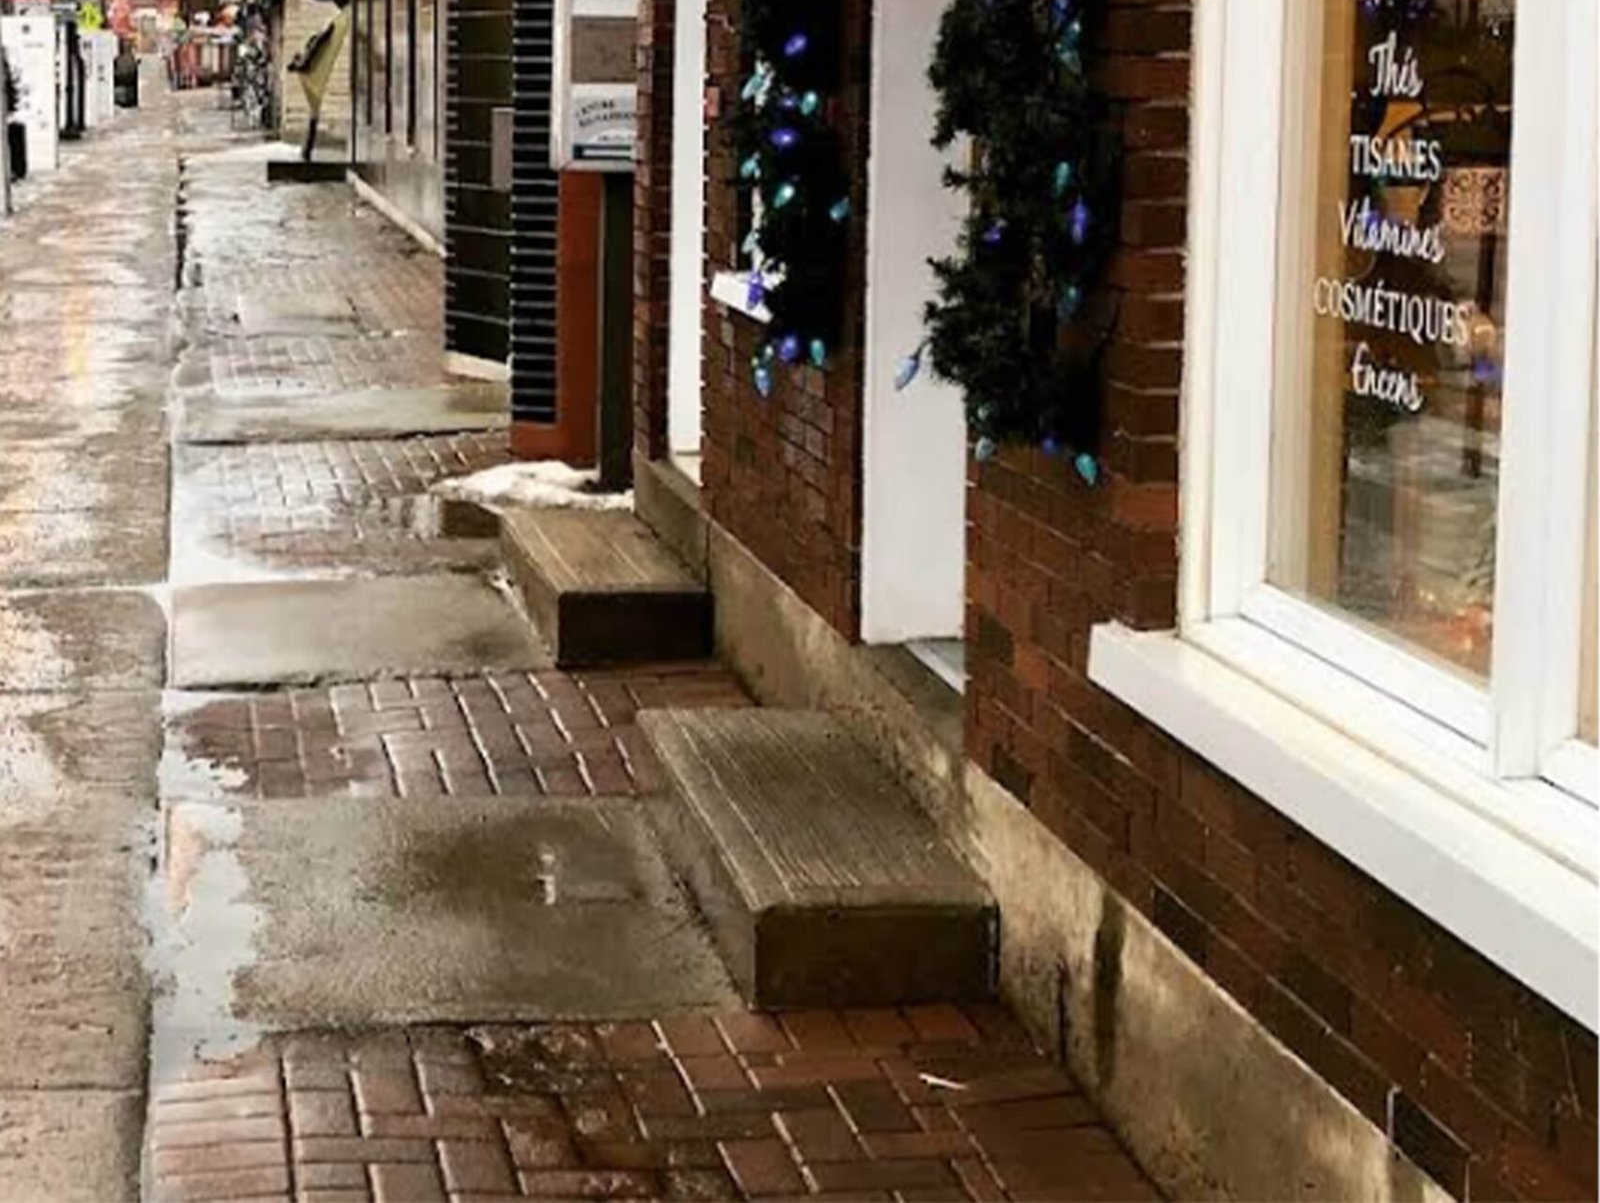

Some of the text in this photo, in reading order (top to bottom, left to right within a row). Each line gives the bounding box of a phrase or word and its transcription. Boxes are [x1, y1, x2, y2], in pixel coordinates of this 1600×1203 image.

[1350, 134, 1441, 182] TISANES
[1338, 195, 1446, 264] Vitamines
[1314, 276, 1469, 346] COSMÉTIQUES
